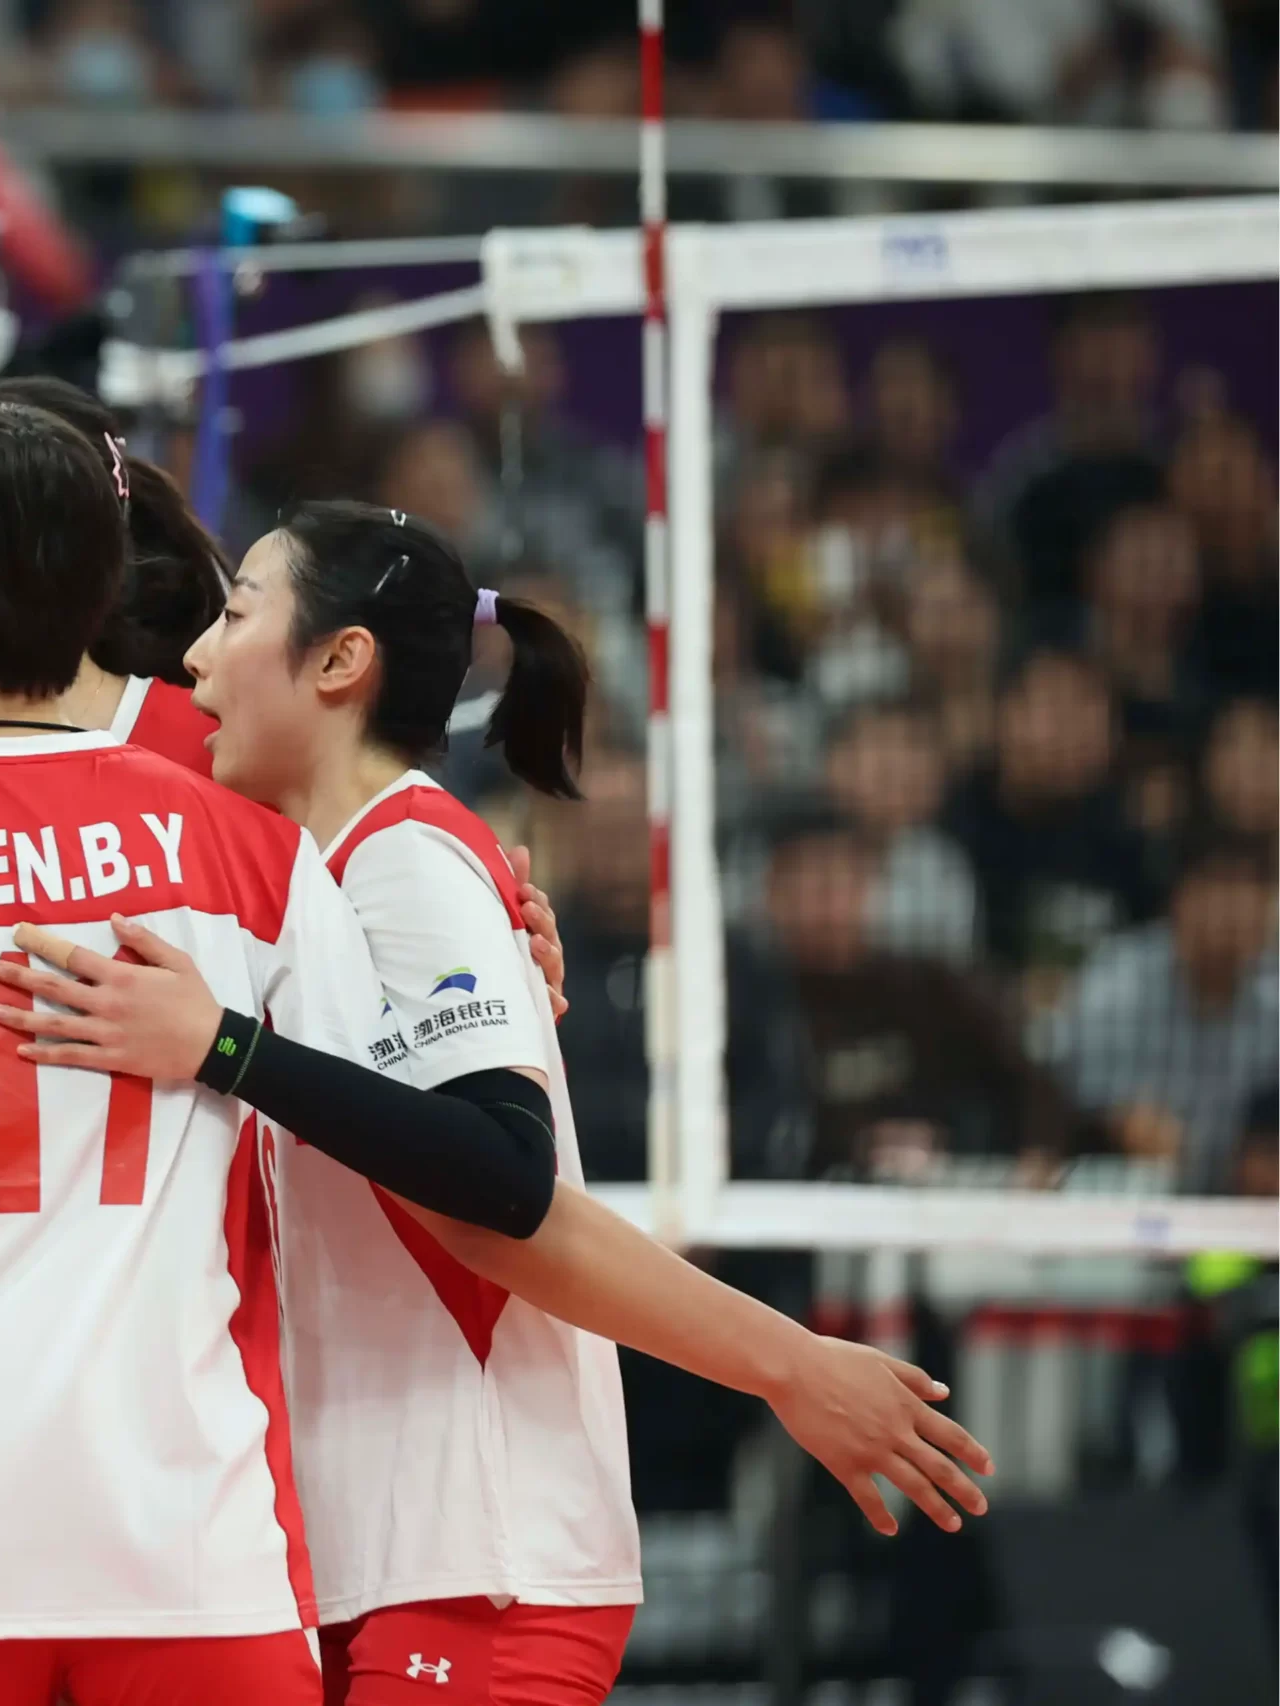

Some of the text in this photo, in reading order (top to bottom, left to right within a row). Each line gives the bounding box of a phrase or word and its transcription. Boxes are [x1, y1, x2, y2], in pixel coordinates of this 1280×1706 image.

[413, 999, 507, 1041] 渤海银行
[413, 1018, 510, 1049] CHINA BOHAI BANK
[377, 1051, 408, 1071] CHINA
